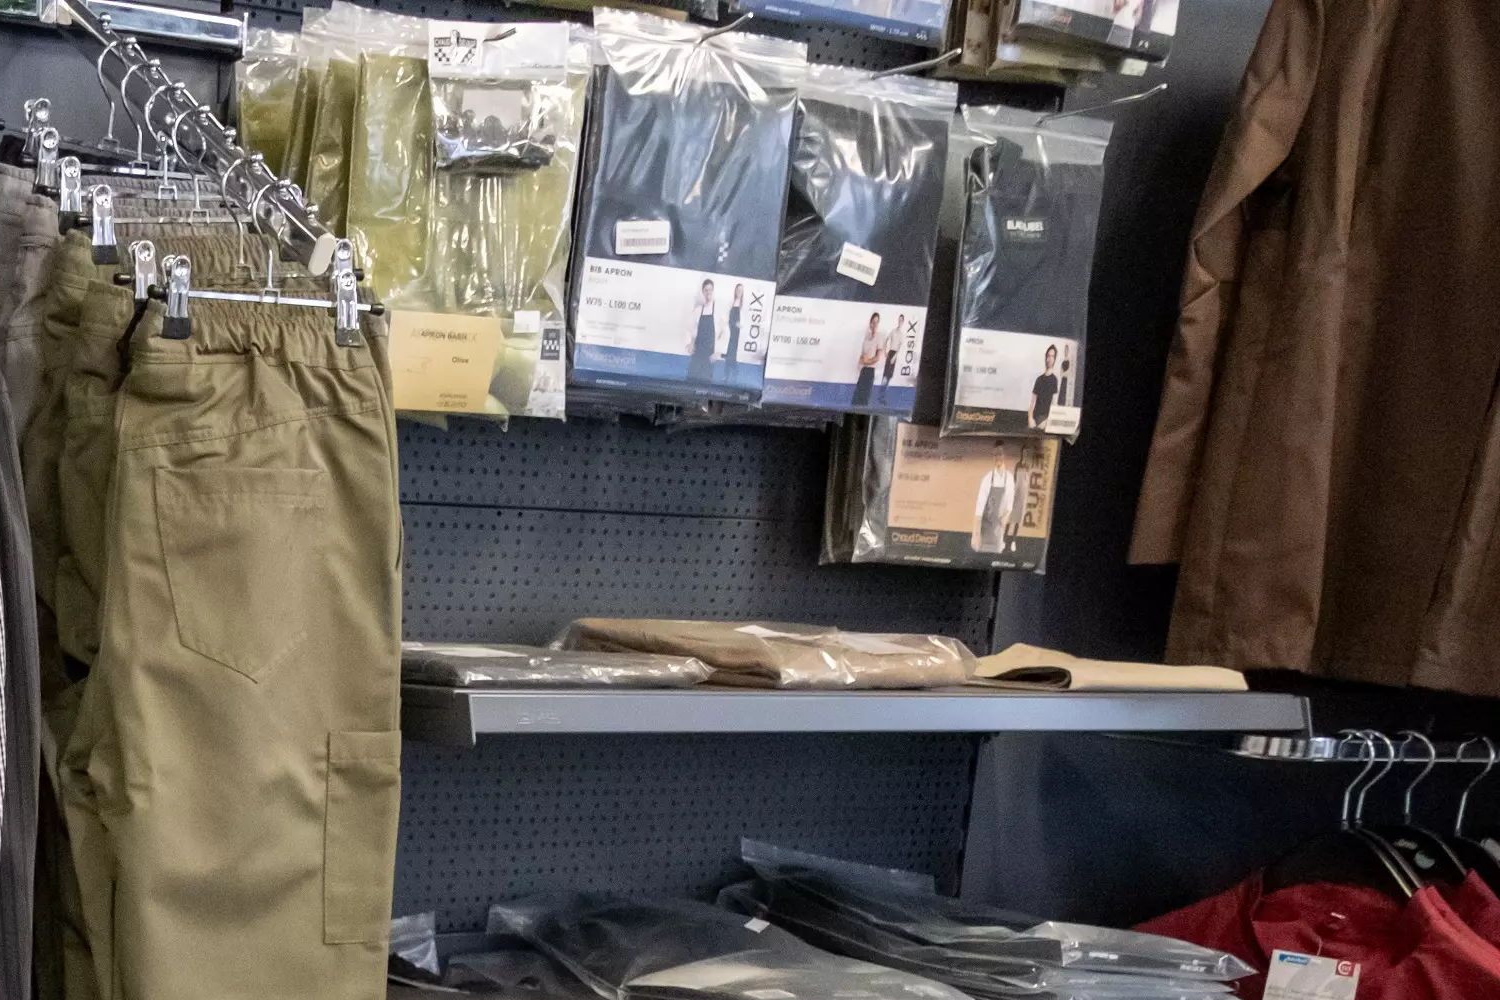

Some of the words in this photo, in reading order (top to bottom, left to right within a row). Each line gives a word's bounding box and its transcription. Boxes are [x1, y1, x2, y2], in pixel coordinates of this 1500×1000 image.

[605, 267, 633, 278] APRON
[776, 305, 803, 315] APRON
[451, 356, 469, 365] Olive
